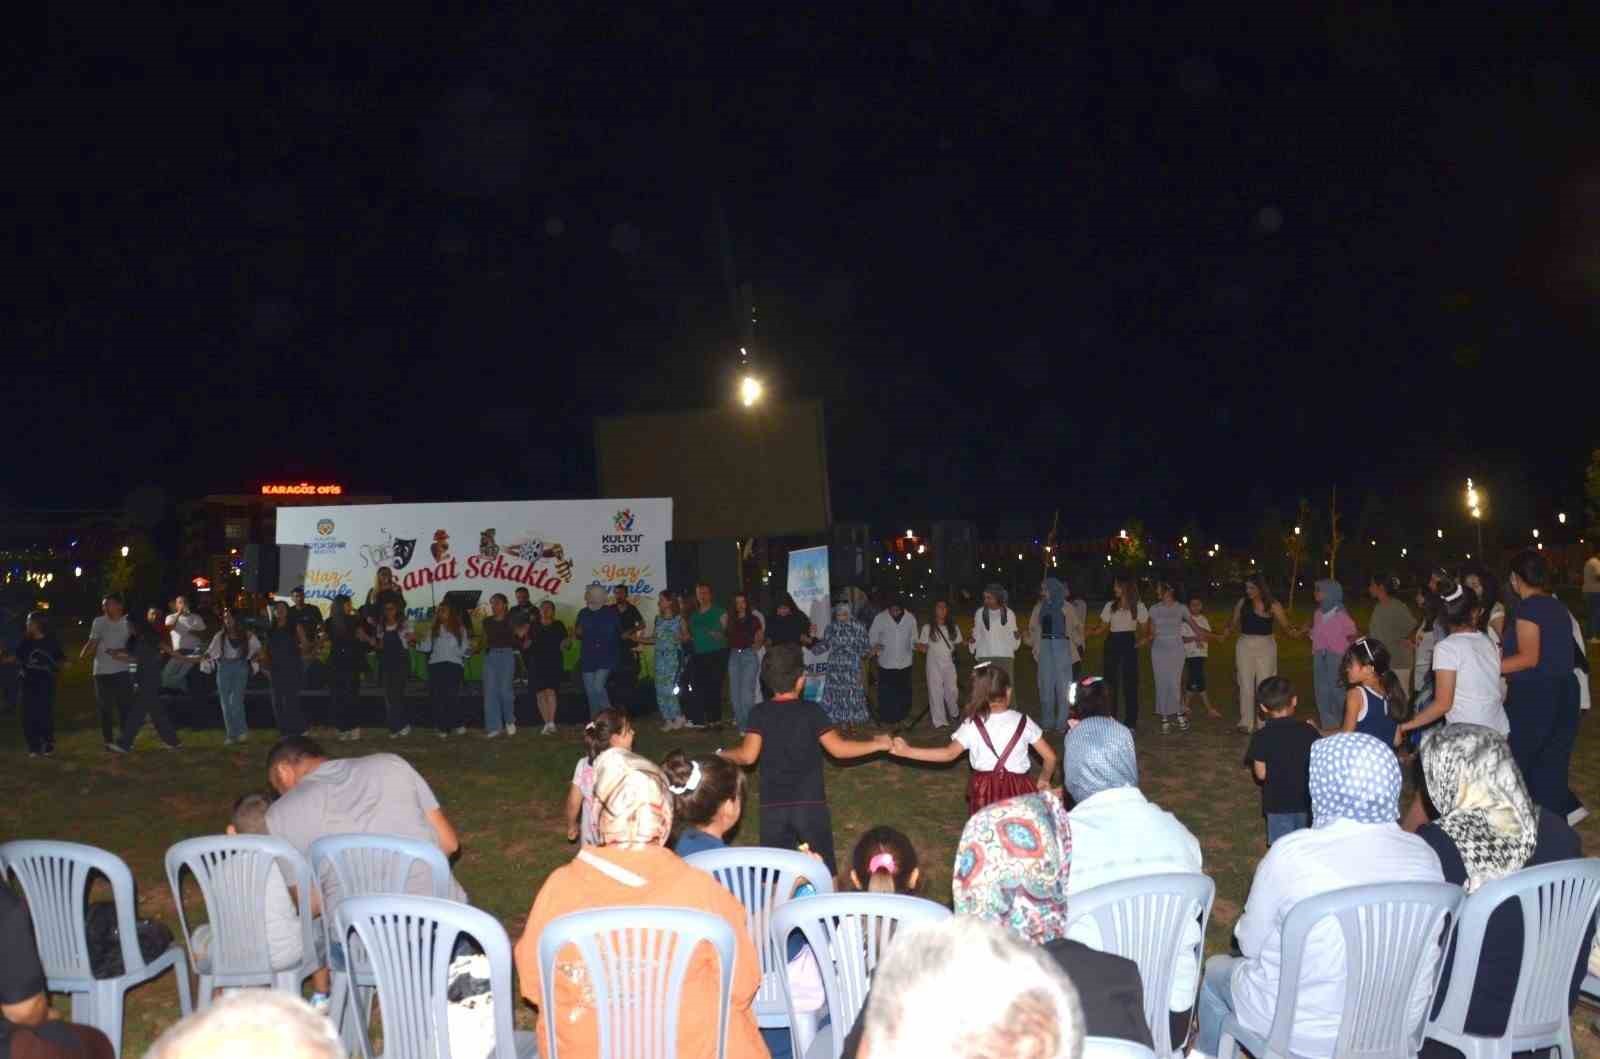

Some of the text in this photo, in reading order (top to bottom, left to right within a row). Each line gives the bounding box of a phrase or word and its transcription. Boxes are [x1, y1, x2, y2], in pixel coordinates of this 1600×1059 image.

[262, 482, 316, 494] KARAGÖZ
[464, 553, 562, 595] Sokakta
[303, 583, 355, 600] eninle
